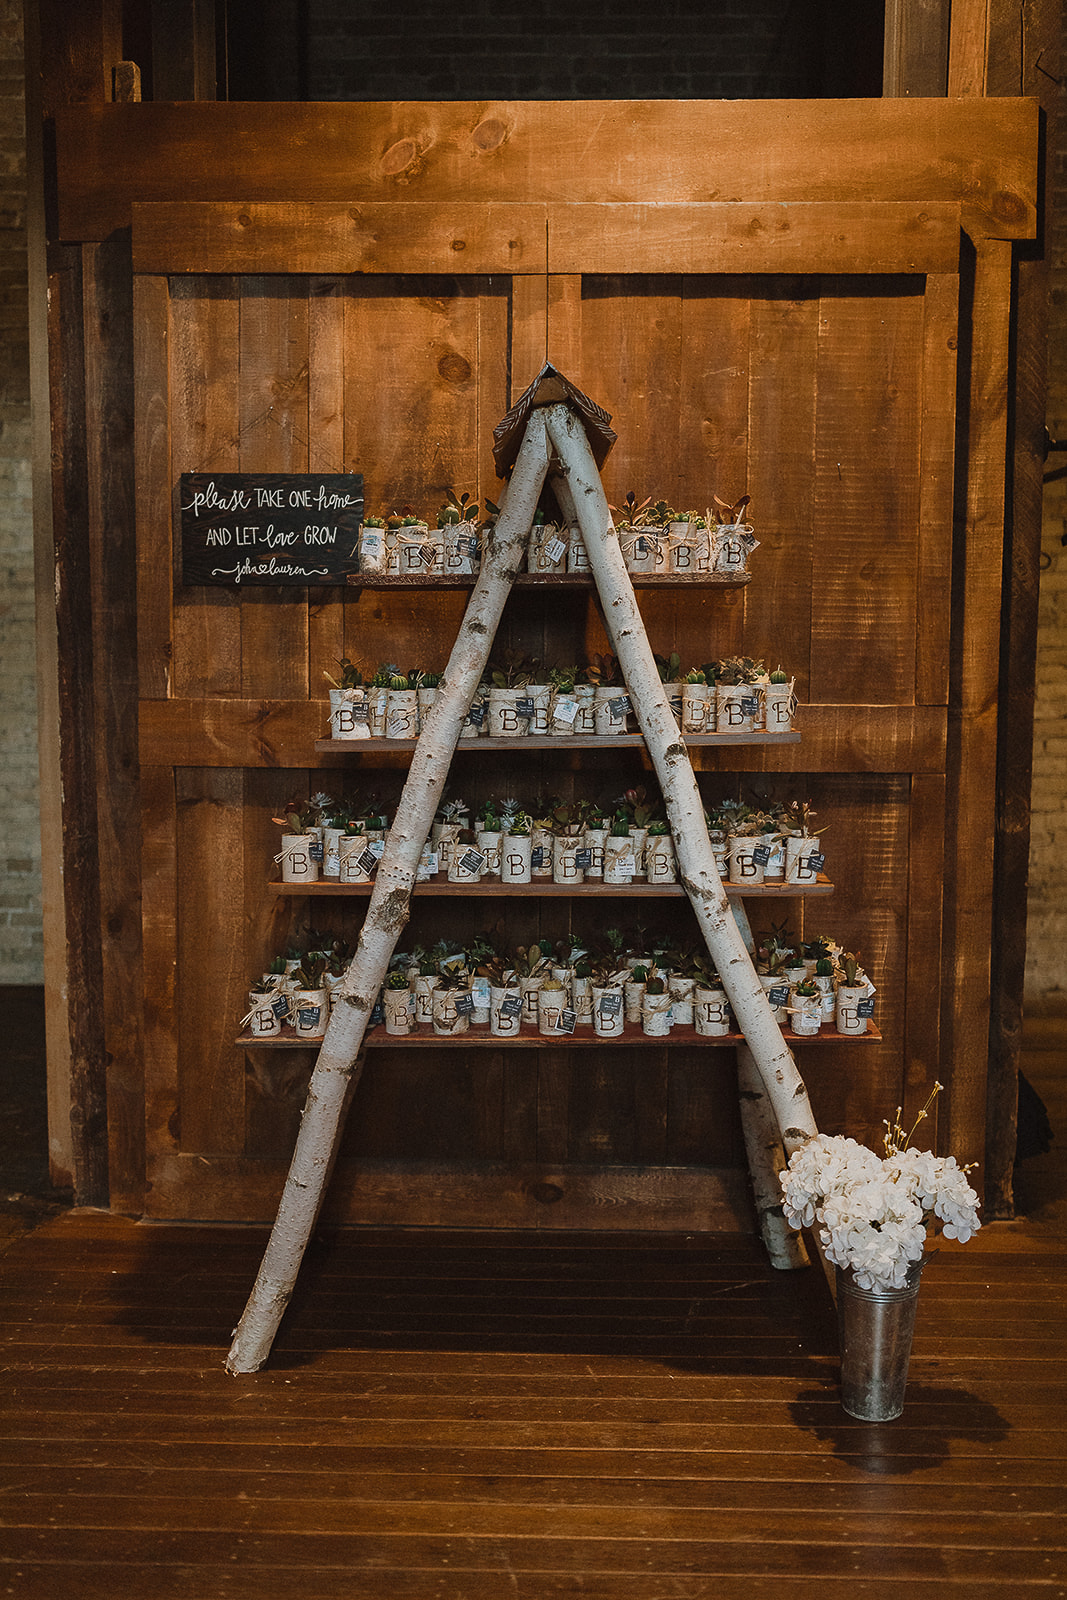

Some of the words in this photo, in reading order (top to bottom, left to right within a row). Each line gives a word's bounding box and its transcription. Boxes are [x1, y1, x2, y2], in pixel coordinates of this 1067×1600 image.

[181, 481, 252, 517] please
[253, 487, 285, 508] TAKE
[288, 489, 313, 508] ONE
[313, 484, 364, 511] home
[205, 527, 232, 546] AND
[235, 526, 260, 546] LET
[258, 523, 299, 548] love
[303, 524, 338, 546] GROW
[674, 545, 691, 567] B
[723, 541, 742, 564] B
[335, 709, 355, 732] B
[499, 708, 519, 731] B
[578, 707, 596, 729] B
[687, 699, 706, 721] B
[724, 703, 744, 726] B
[288, 852, 308, 874] B
[506, 854, 525, 876] B
[559, 856, 578, 878] B
[651, 853, 669, 876] B
[736, 854, 757, 877] B
[255, 1008, 275, 1032] B
[702, 1002, 723, 1023] B
[840, 1007, 861, 1029] B
